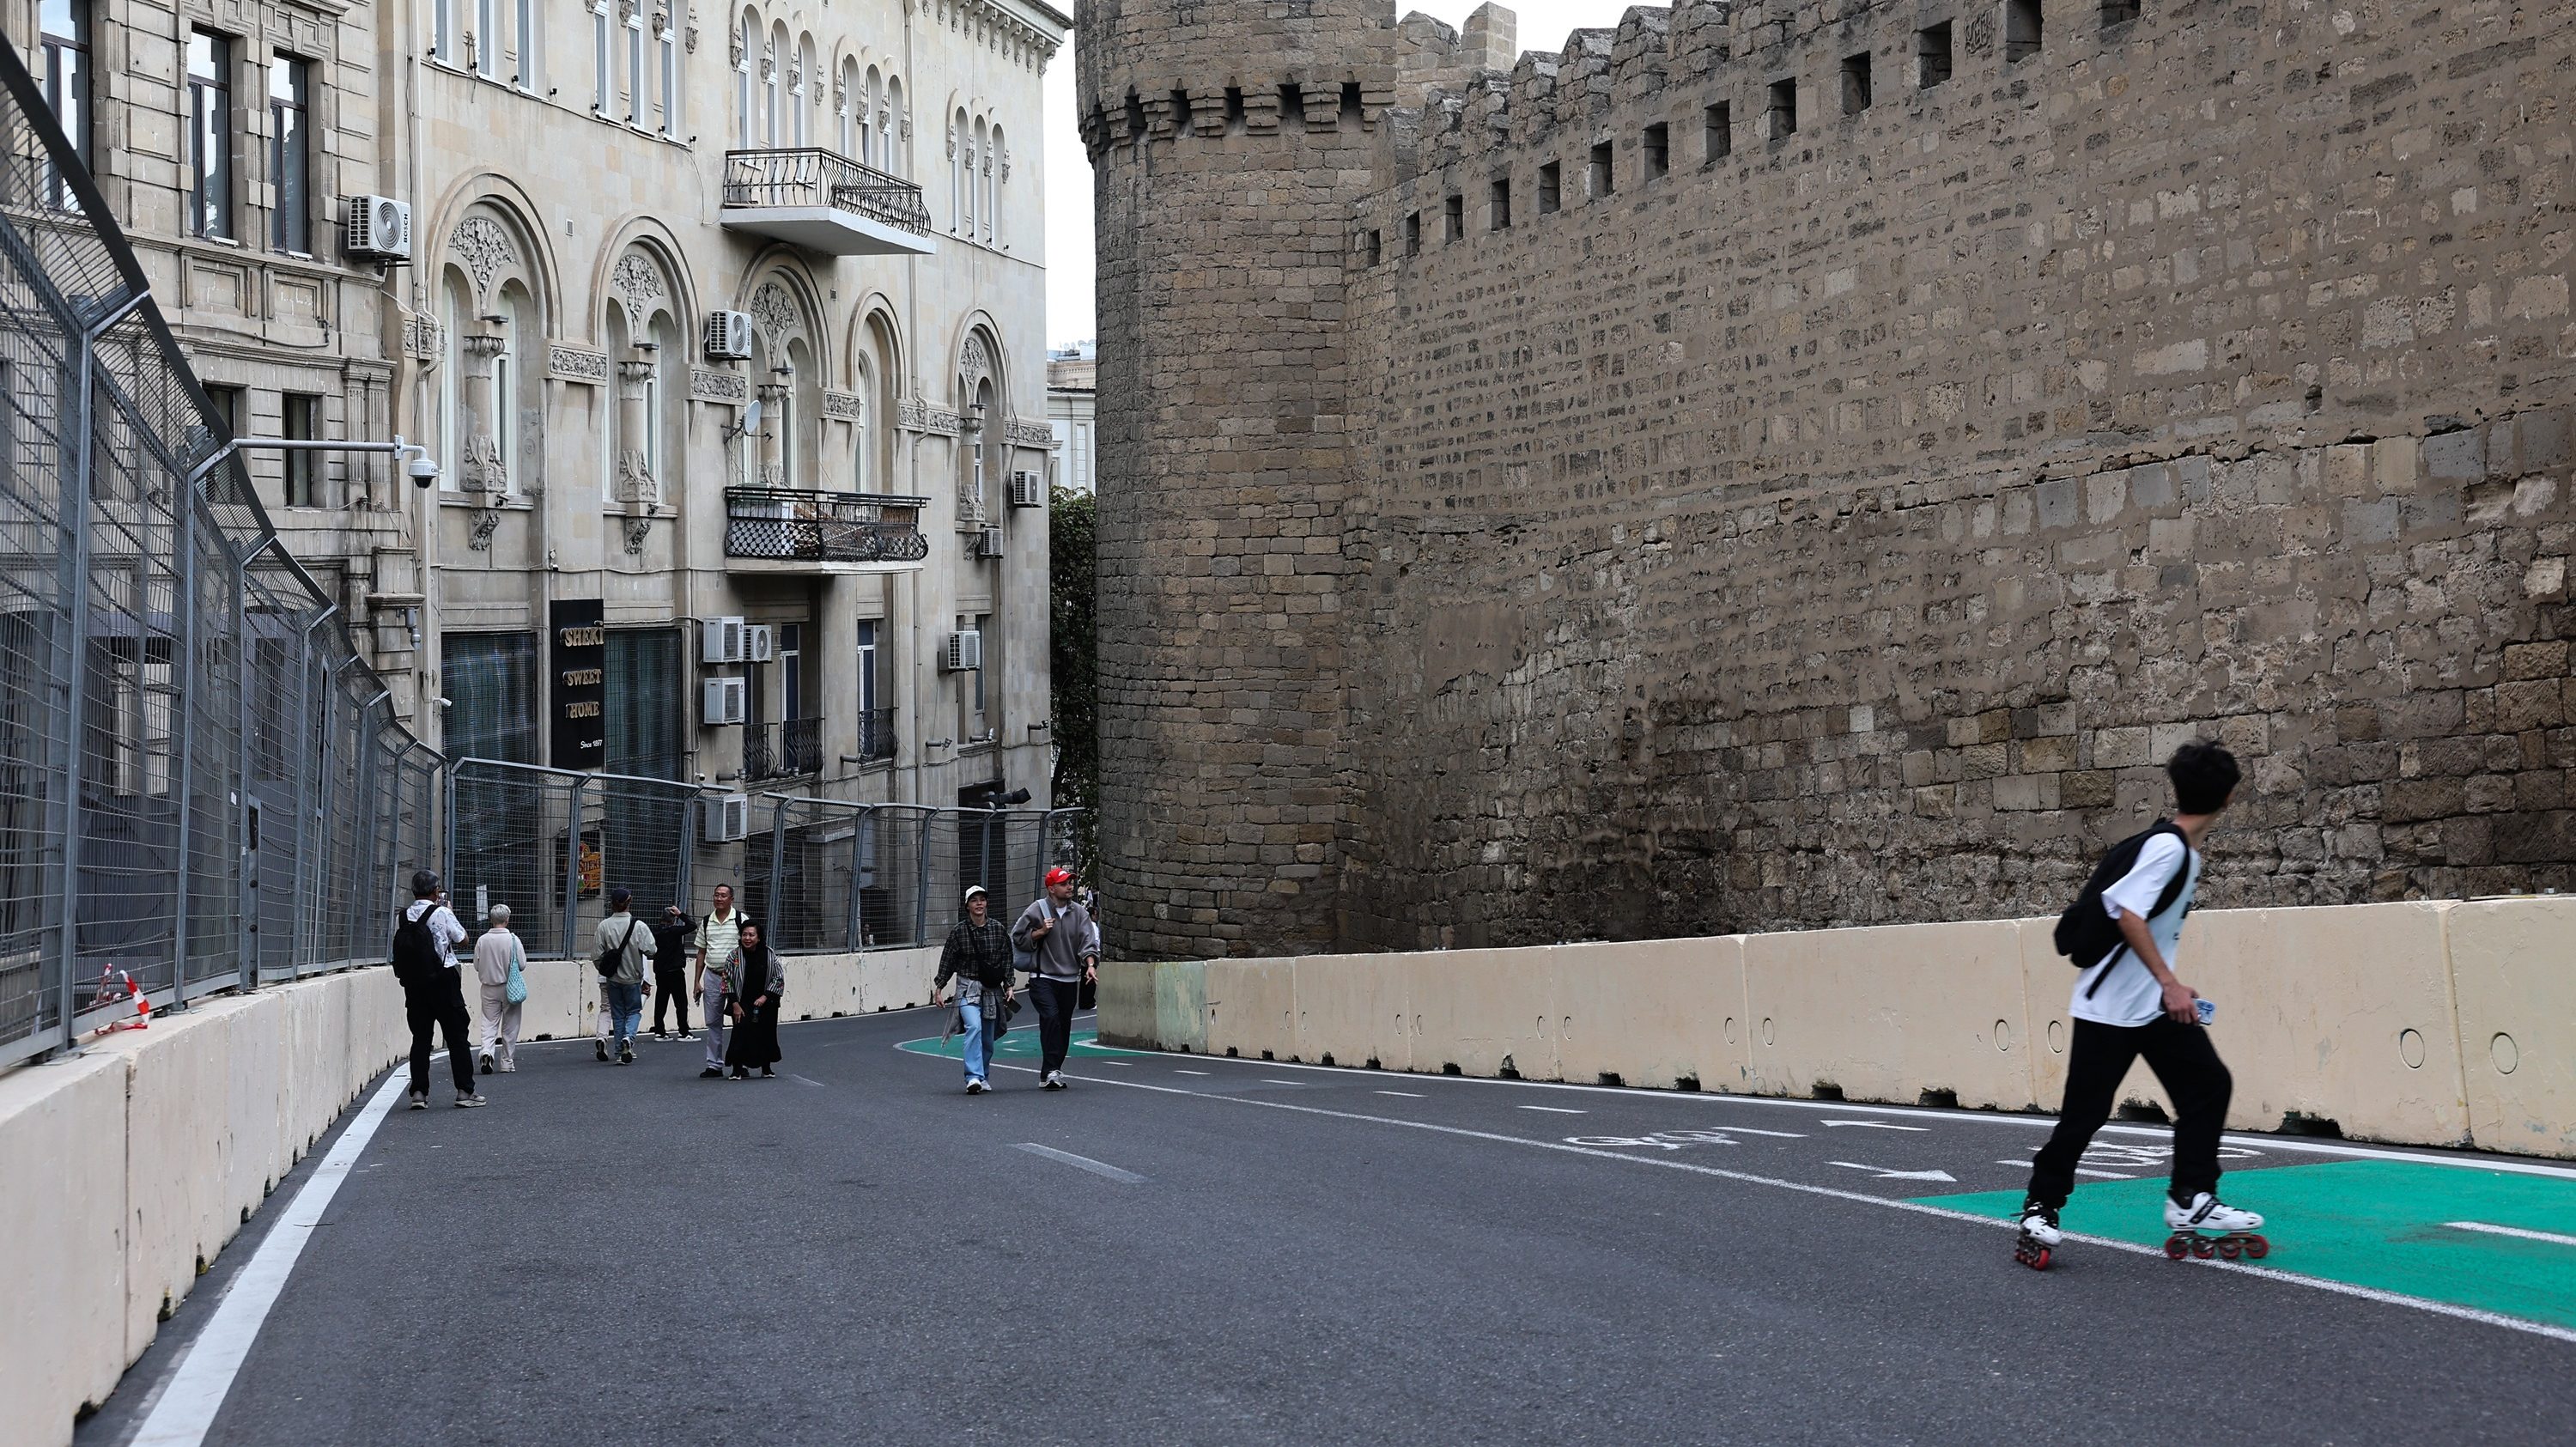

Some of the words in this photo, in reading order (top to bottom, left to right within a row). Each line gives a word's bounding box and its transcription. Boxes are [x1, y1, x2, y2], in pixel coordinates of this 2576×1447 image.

[563, 669, 601, 686] SWEET
[567, 702, 599, 718] HOME
[580, 740, 592, 749] Since
